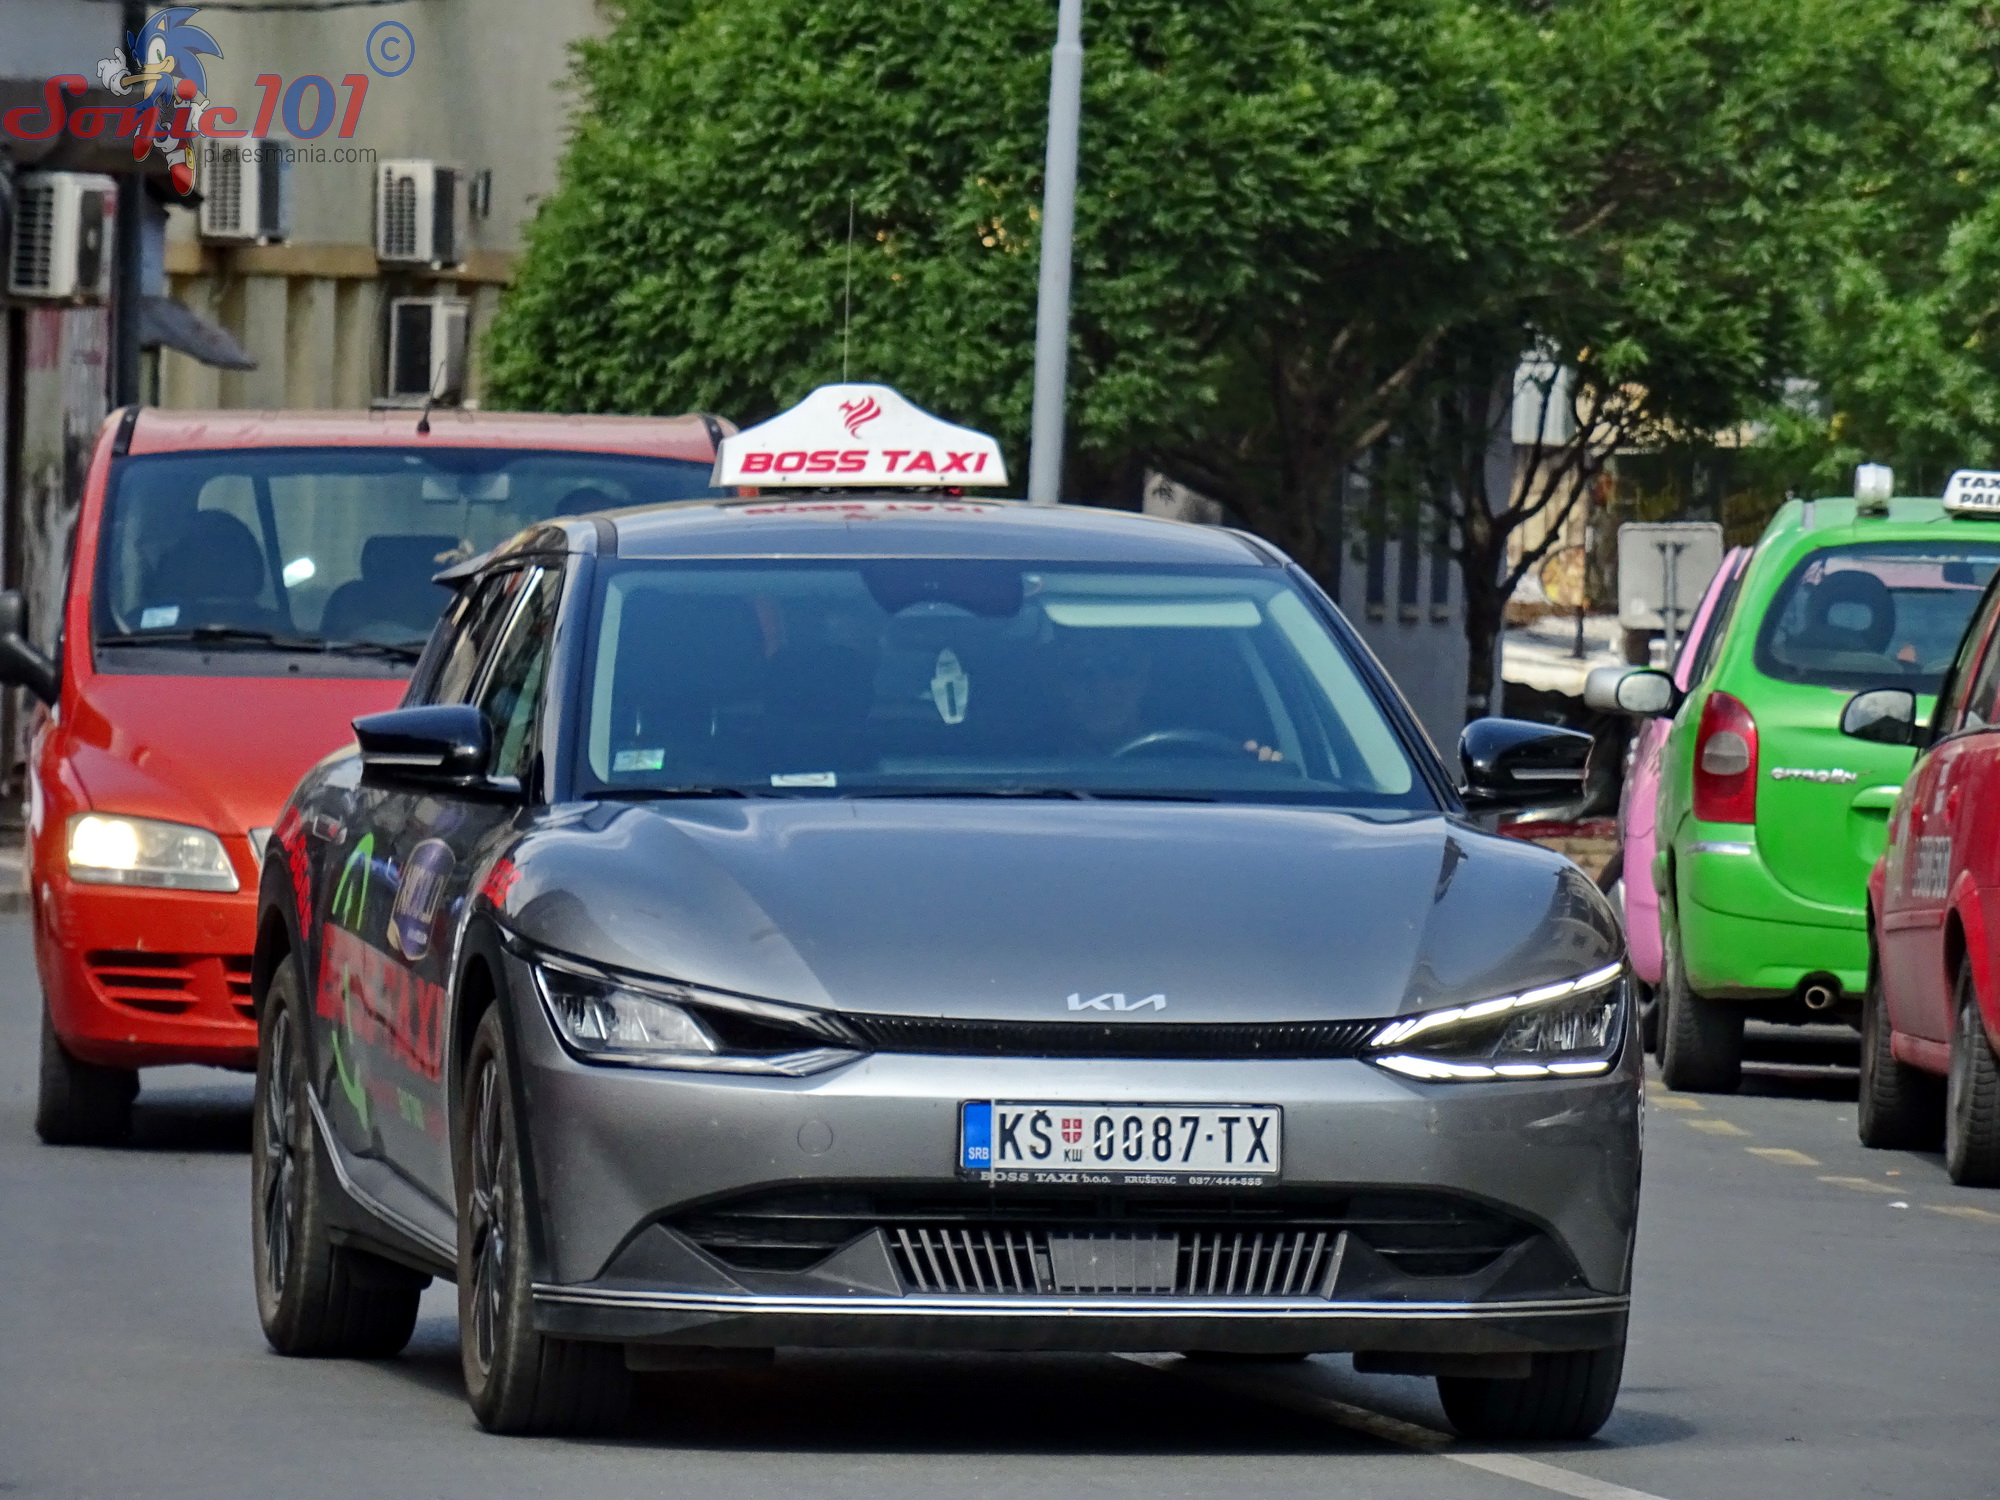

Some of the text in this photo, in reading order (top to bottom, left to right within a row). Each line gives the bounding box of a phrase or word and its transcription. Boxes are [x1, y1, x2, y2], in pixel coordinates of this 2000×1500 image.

[740, 450, 988, 474] BOSS TAXI
[1067, 993, 1167, 1012] KIA
[999, 1110, 1053, 1161] KŠ
[968, 1147, 990, 1160] SRB
[980, 1171, 1029, 1182] BOSS
[1034, 1173, 1078, 1184] TAXI
[1124, 1174, 1177, 1185] KRUŠEVAC
[1188, 1176, 1263, 1187] 037/444-555
